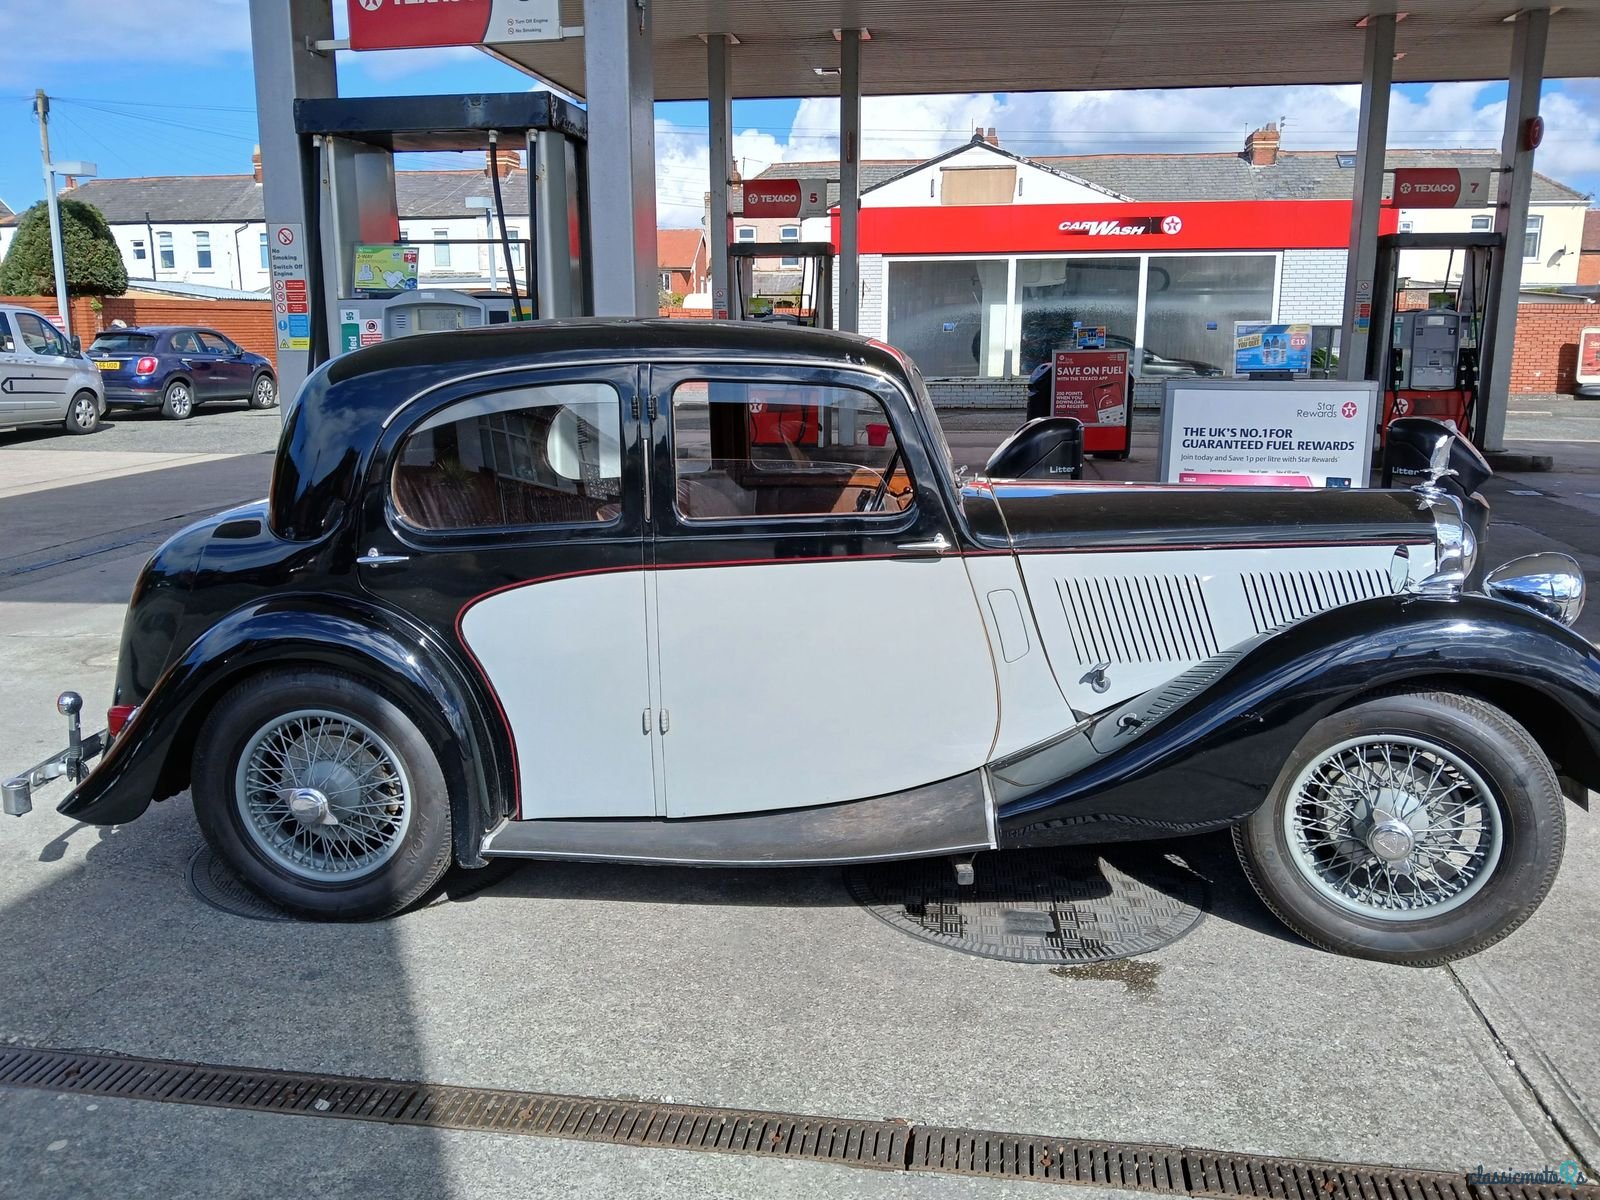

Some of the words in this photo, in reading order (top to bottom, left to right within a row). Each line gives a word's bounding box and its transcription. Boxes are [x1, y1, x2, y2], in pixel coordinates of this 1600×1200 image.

[1414, 184, 1456, 193] TEXACO
[1470, 182, 1480, 194] 7
[760, 194, 797, 203] TEXACO
[809, 193, 818, 203] 5
[1290, 338, 1306, 346] £10
[1057, 367, 1081, 375] SAVE
[1083, 367, 1100, 375] ON
[1101, 366, 1123, 375] FUEL
[1317, 402, 1335, 411] Star
[1297, 409, 1337, 418] Rewards
[1183, 427, 1206, 437] THE
[1209, 427, 1237, 438] UK'S
[1182, 439, 1264, 450] GUARANTEED
[1266, 440, 1295, 450] FUEL
[1297, 441, 1355, 451] REWARDS
[1181, 453, 1193, 462] Join
[1194, 454, 1214, 463] today
[1214, 454, 1228, 462] and
[1246, 455, 1254, 464] 1p
[1267, 455, 1281, 463] litre
[1282, 455, 1297, 463] with
[1392, 466, 1420, 476] Litter
